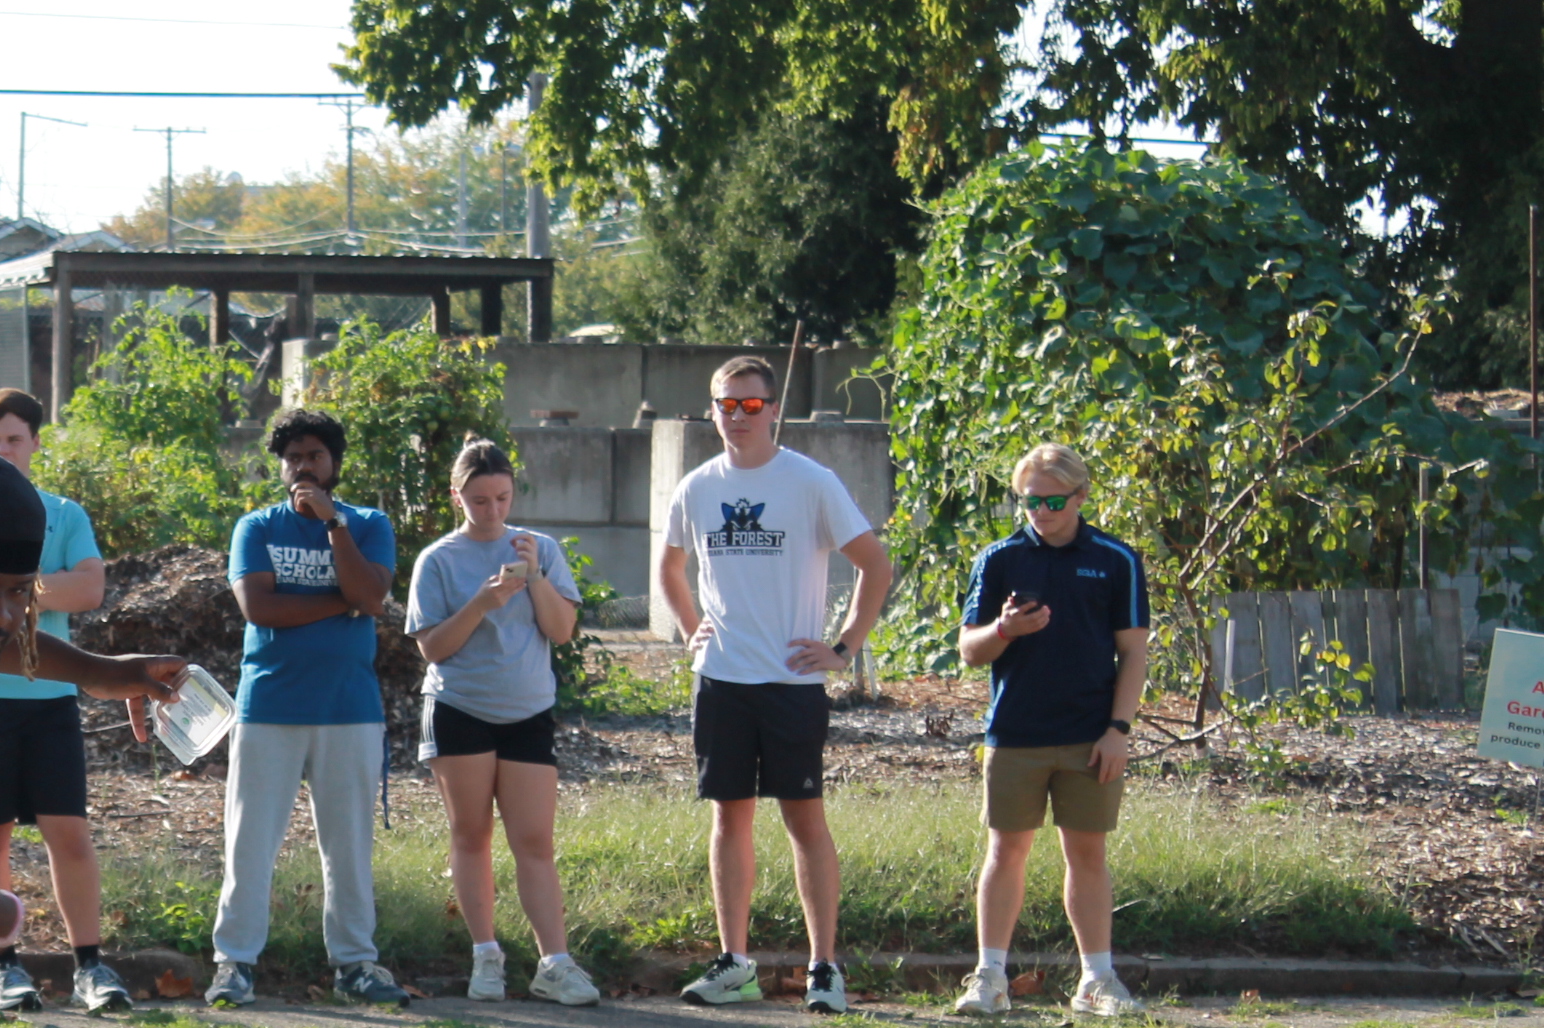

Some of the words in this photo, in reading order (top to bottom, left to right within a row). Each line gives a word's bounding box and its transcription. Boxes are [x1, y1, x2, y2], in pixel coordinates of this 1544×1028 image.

[703, 531, 727, 547] THE
[732, 531, 784, 546] FOREST
[271, 546, 332, 566] SUMM
[275, 562, 337, 580] SCHOLA
[1490, 734, 1541, 750] produce
